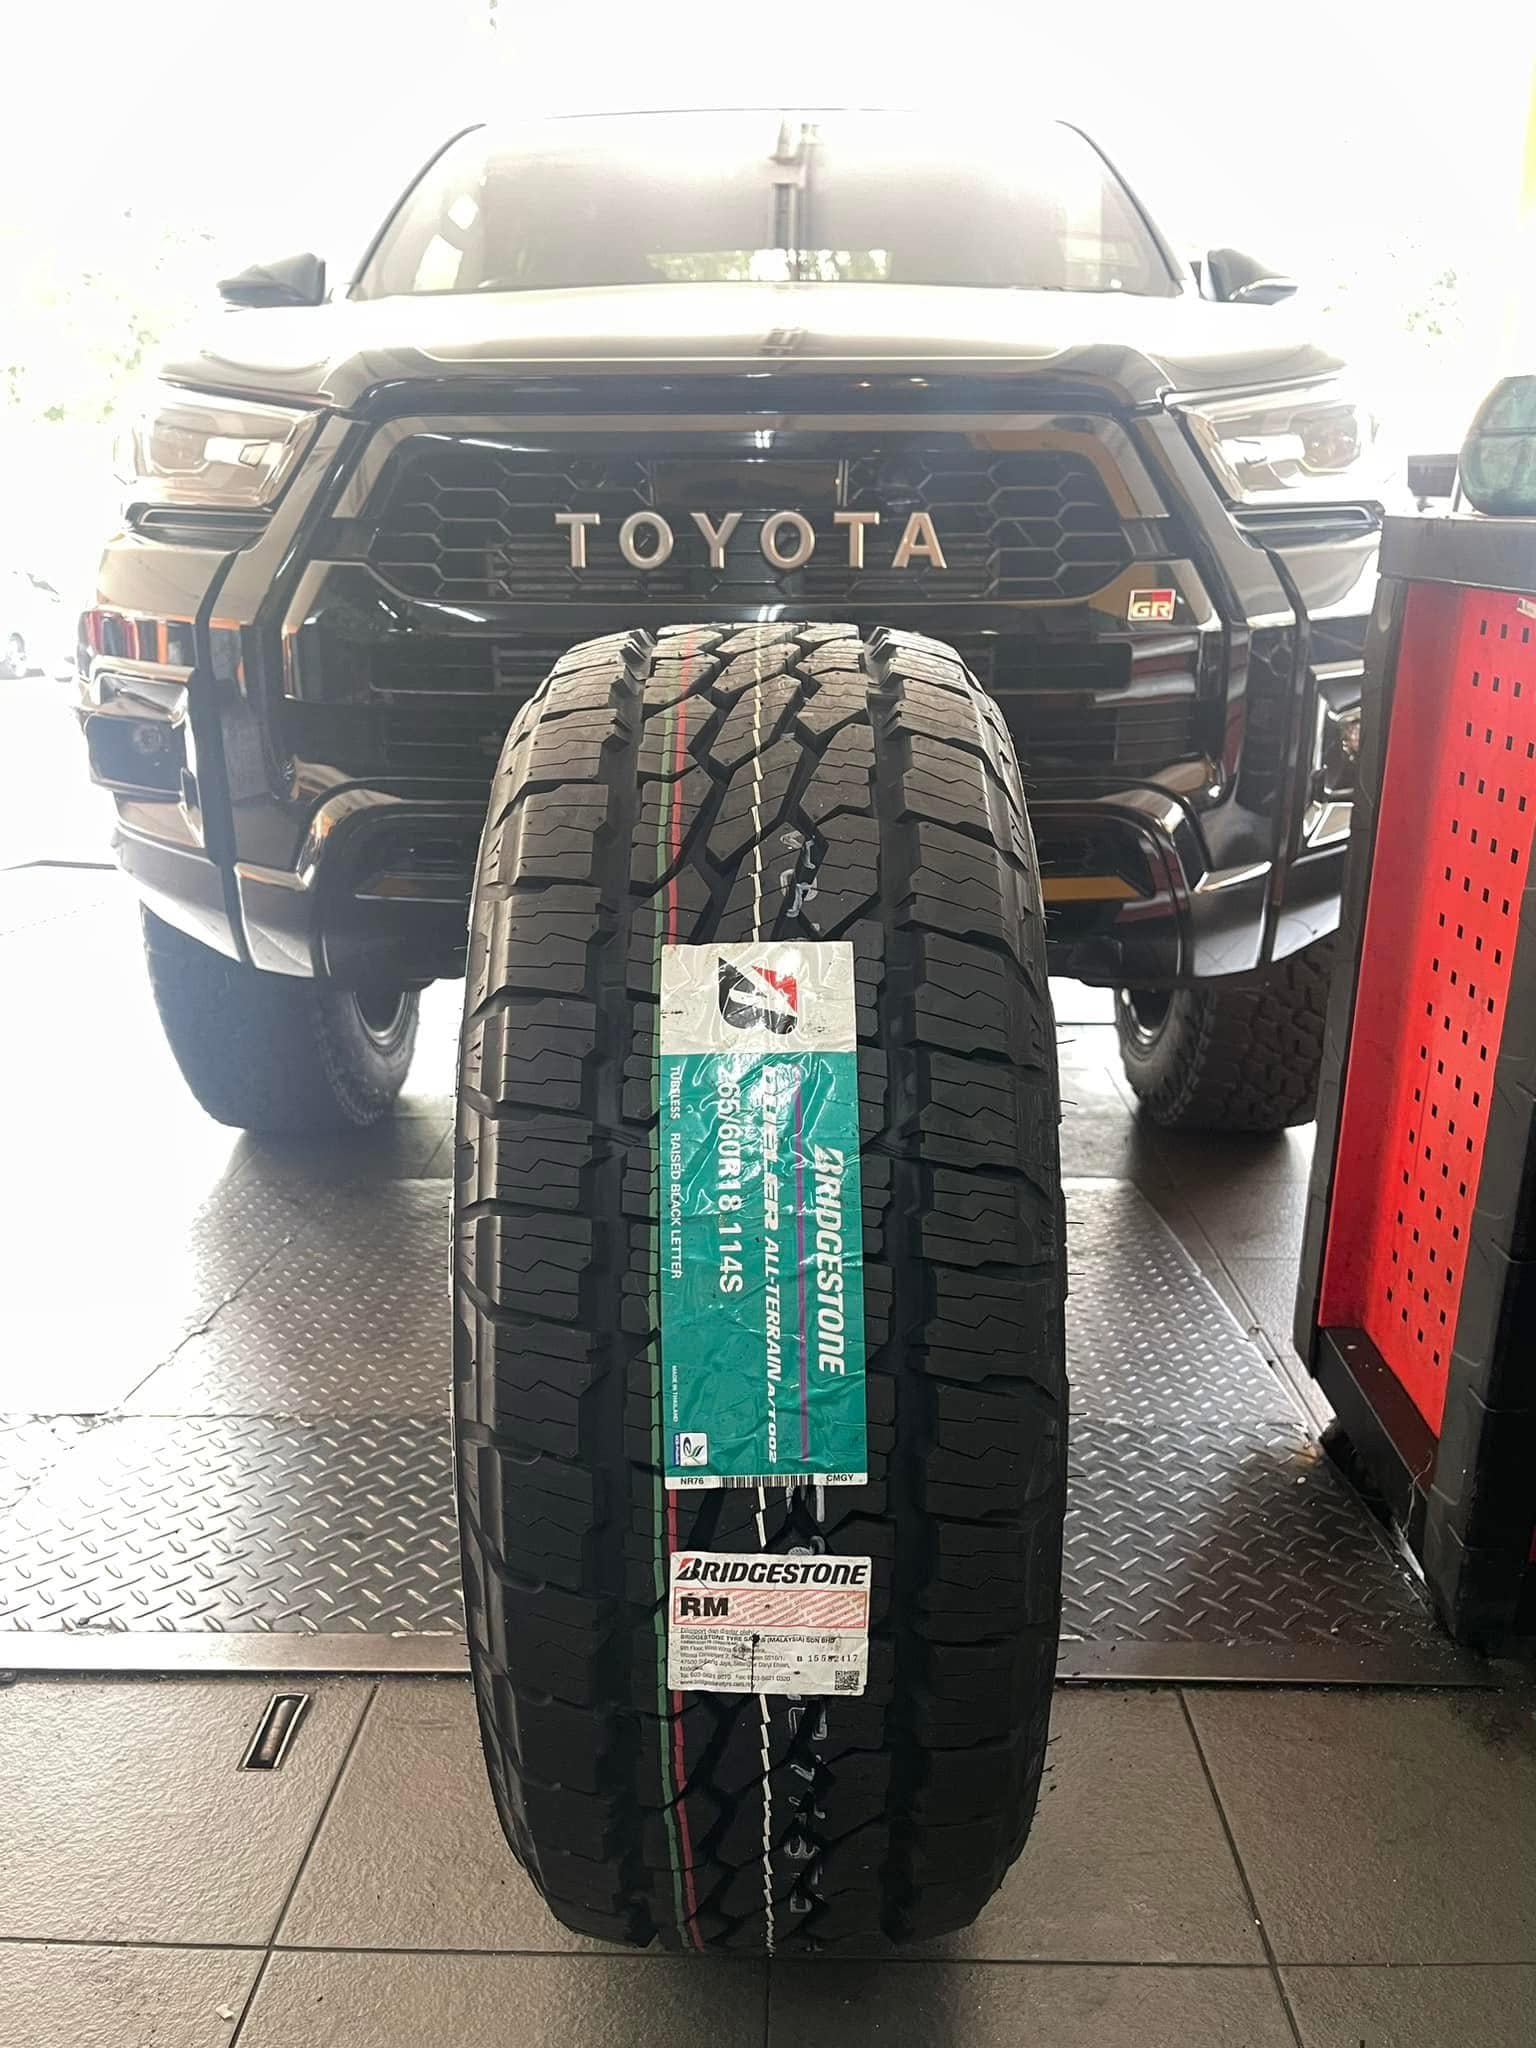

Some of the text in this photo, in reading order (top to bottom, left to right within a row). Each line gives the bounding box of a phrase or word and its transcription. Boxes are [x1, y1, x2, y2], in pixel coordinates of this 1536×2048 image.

[555, 511, 947, 570] TOYOTA
[1132, 601, 1171, 617] GR
[669, 1066, 682, 1280] TUBELESS RAISED BLACK LETTER
[717, 1067, 744, 1294] 265/60R18 114S
[763, 1065, 782, 1464] DUELER ALL-TERRAIN A/T002
[814, 1144, 846, 1376] BRIDGESTONE
[680, 1477, 704, 1485] NR76
[825, 1473, 854, 1483] CMGY
[675, 1558, 868, 1585] BRIDGESTONE
[680, 1596, 729, 1617] RM
